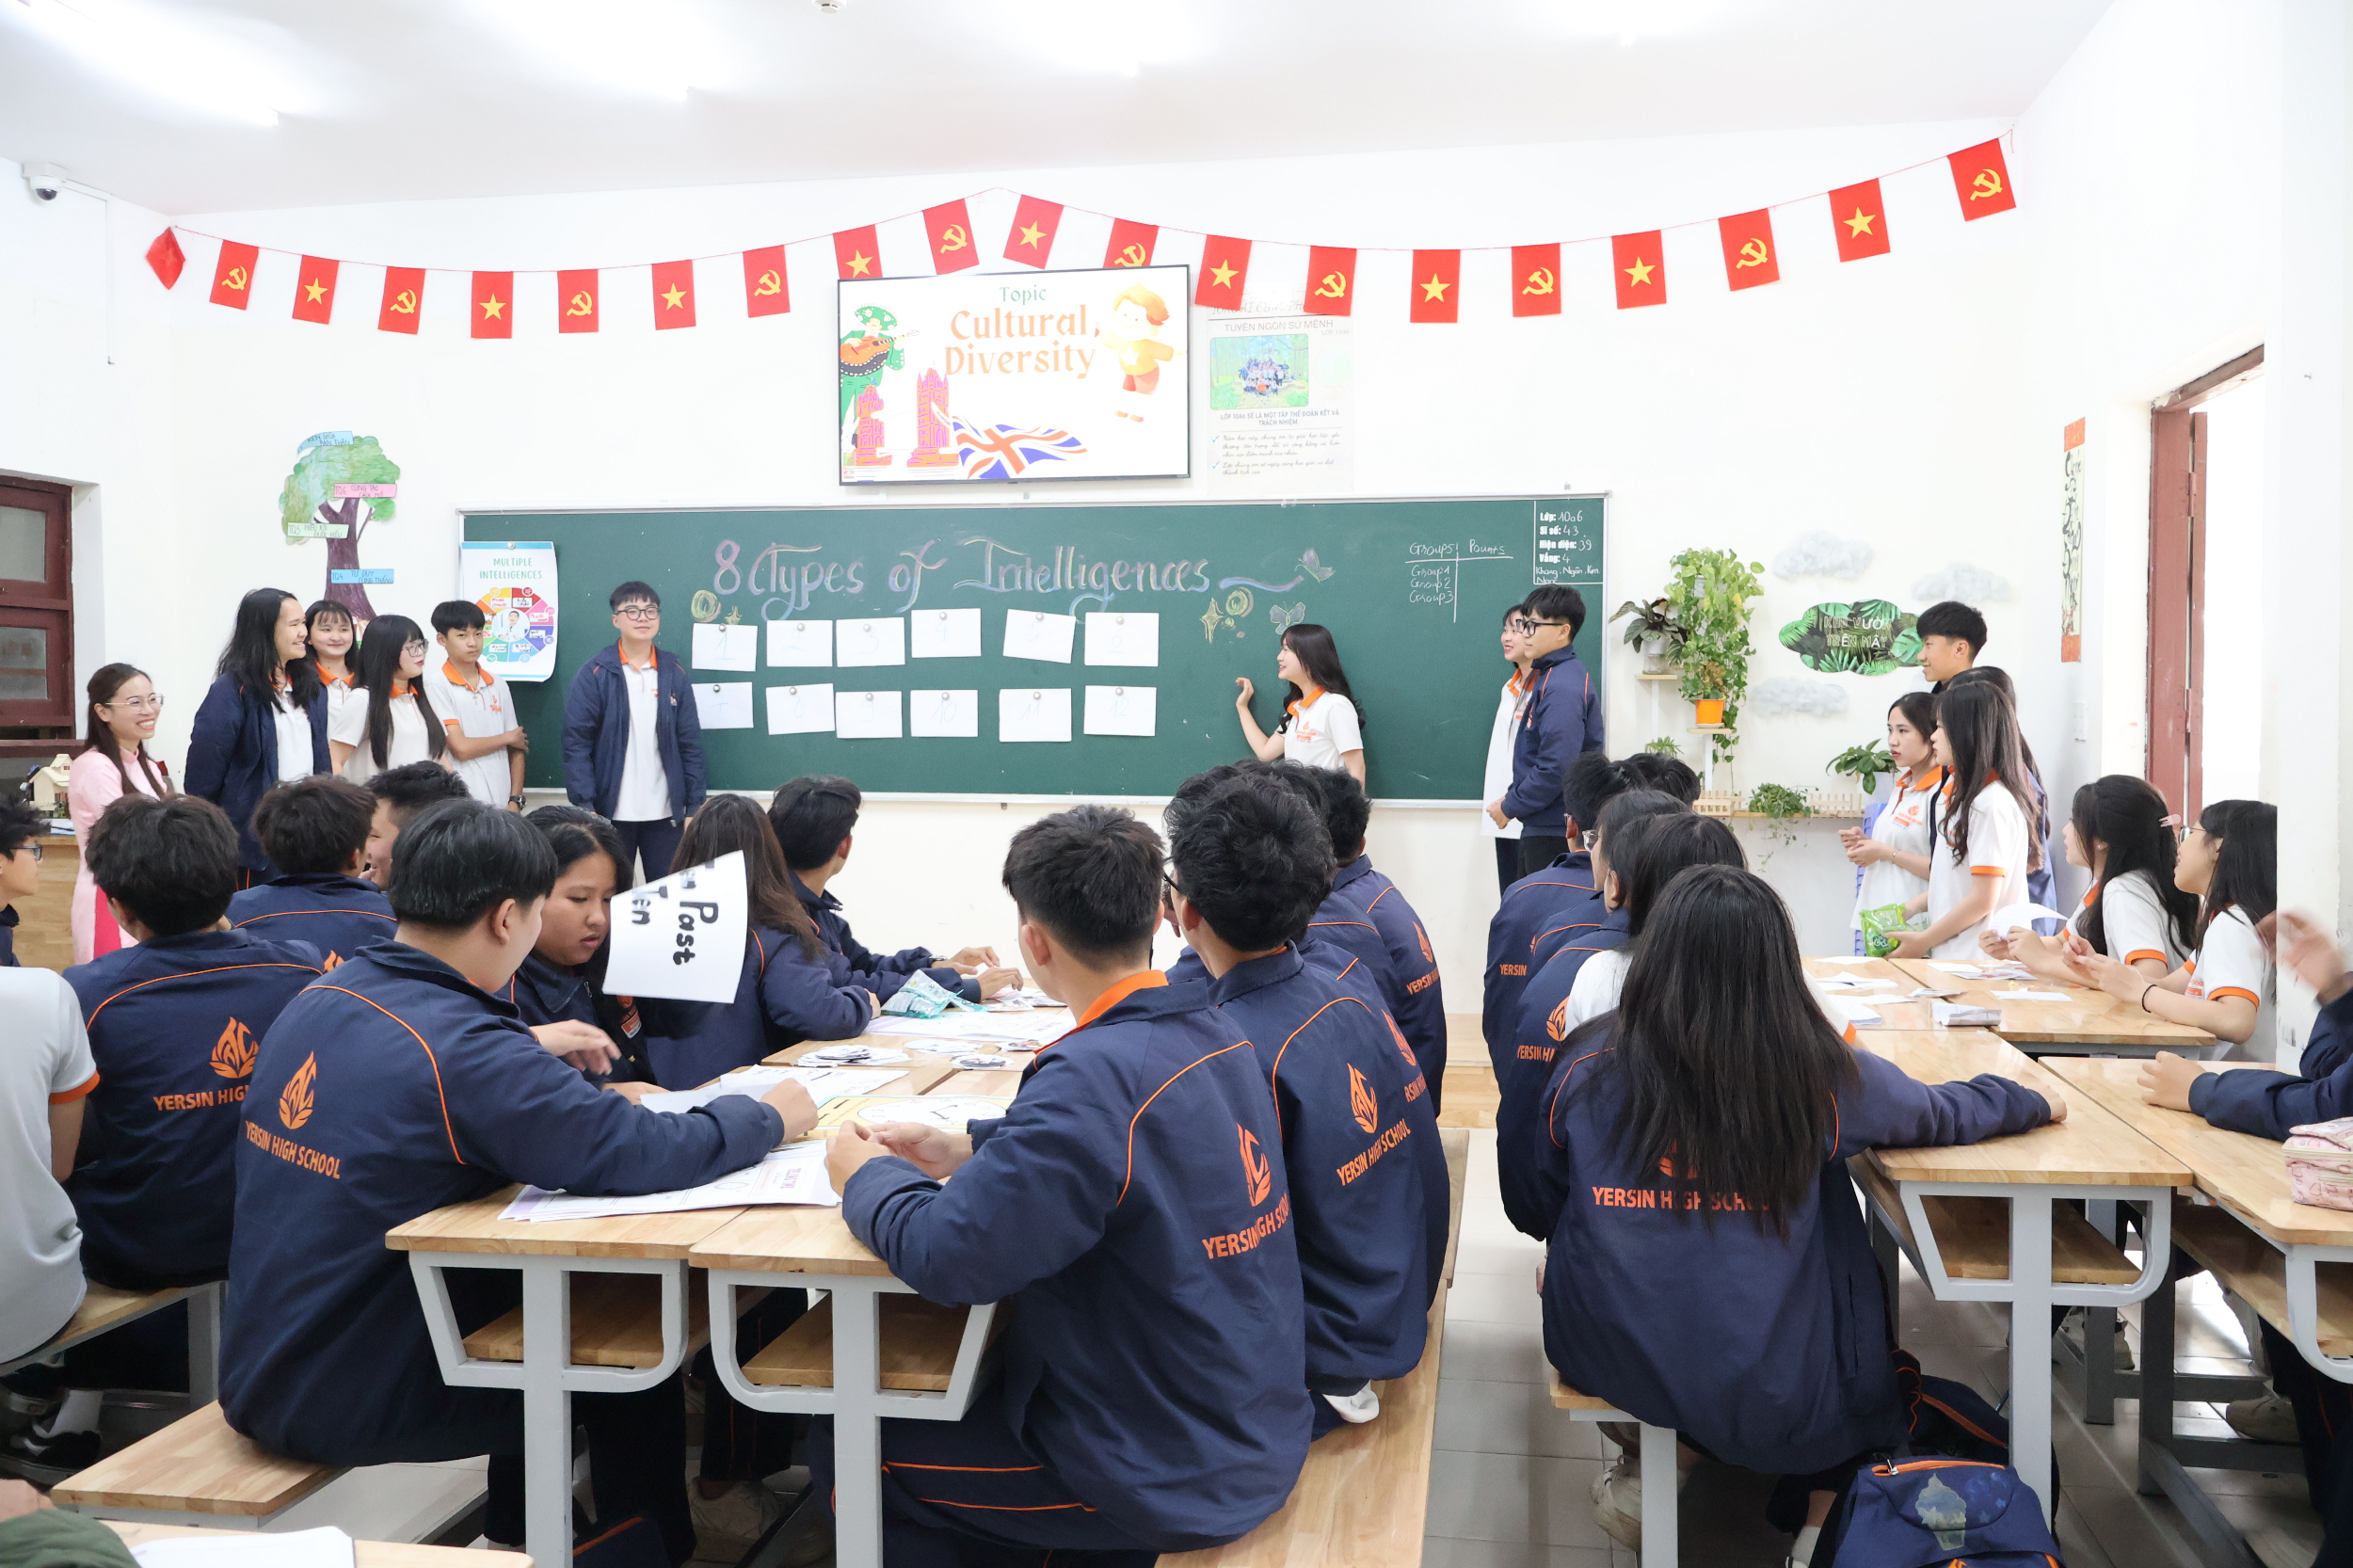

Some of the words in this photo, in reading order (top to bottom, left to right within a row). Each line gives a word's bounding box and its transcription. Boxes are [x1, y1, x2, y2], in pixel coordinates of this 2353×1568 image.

[999, 284, 1048, 306] Topic
[951, 304, 1088, 340] Cultural
[944, 340, 1097, 379] Diversity
[1562, 524, 1579, 536] 43
[1578, 539, 1593, 552] 39
[1562, 552, 1571, 564] 4
[712, 539, 742, 596] 8
[747, 542, 865, 622] Types
[888, 539, 948, 614] of
[780, 628, 810, 652] 2
[860, 626, 879, 654] 3
[936, 622, 949, 643] 4
[1028, 620, 1044, 642] 5
[1826, 633, 1858, 648] TRÊN
[1861, 634, 1888, 648] MÂY
[713, 632, 735, 661] 1
[712, 694, 728, 715] 7
[793, 696, 805, 719] 8
[861, 697, 875, 723] 9
[932, 698, 957, 726] 10
[1020, 701, 1040, 721] 11
[1108, 696, 1130, 720] 12
[672, 901, 719, 966] Past
[1499, 964, 1528, 976] YERSIN
[1543, 1047, 1556, 1063] HI
[152, 1091, 215, 1112] YERSIN
[245, 1120, 272, 1152] YERSIN
[271, 1136, 298, 1163] HIGH
[297, 1145, 341, 1179] SCHOOL
[1336, 1151, 1369, 1187] YERSIN
[1368, 1138, 1384, 1167] HIGH
[1381, 1117, 1412, 1153] SCHOOL
[1592, 1186, 1657, 1208] YERSIN
[1201, 1220, 1260, 1260] YERSIN
